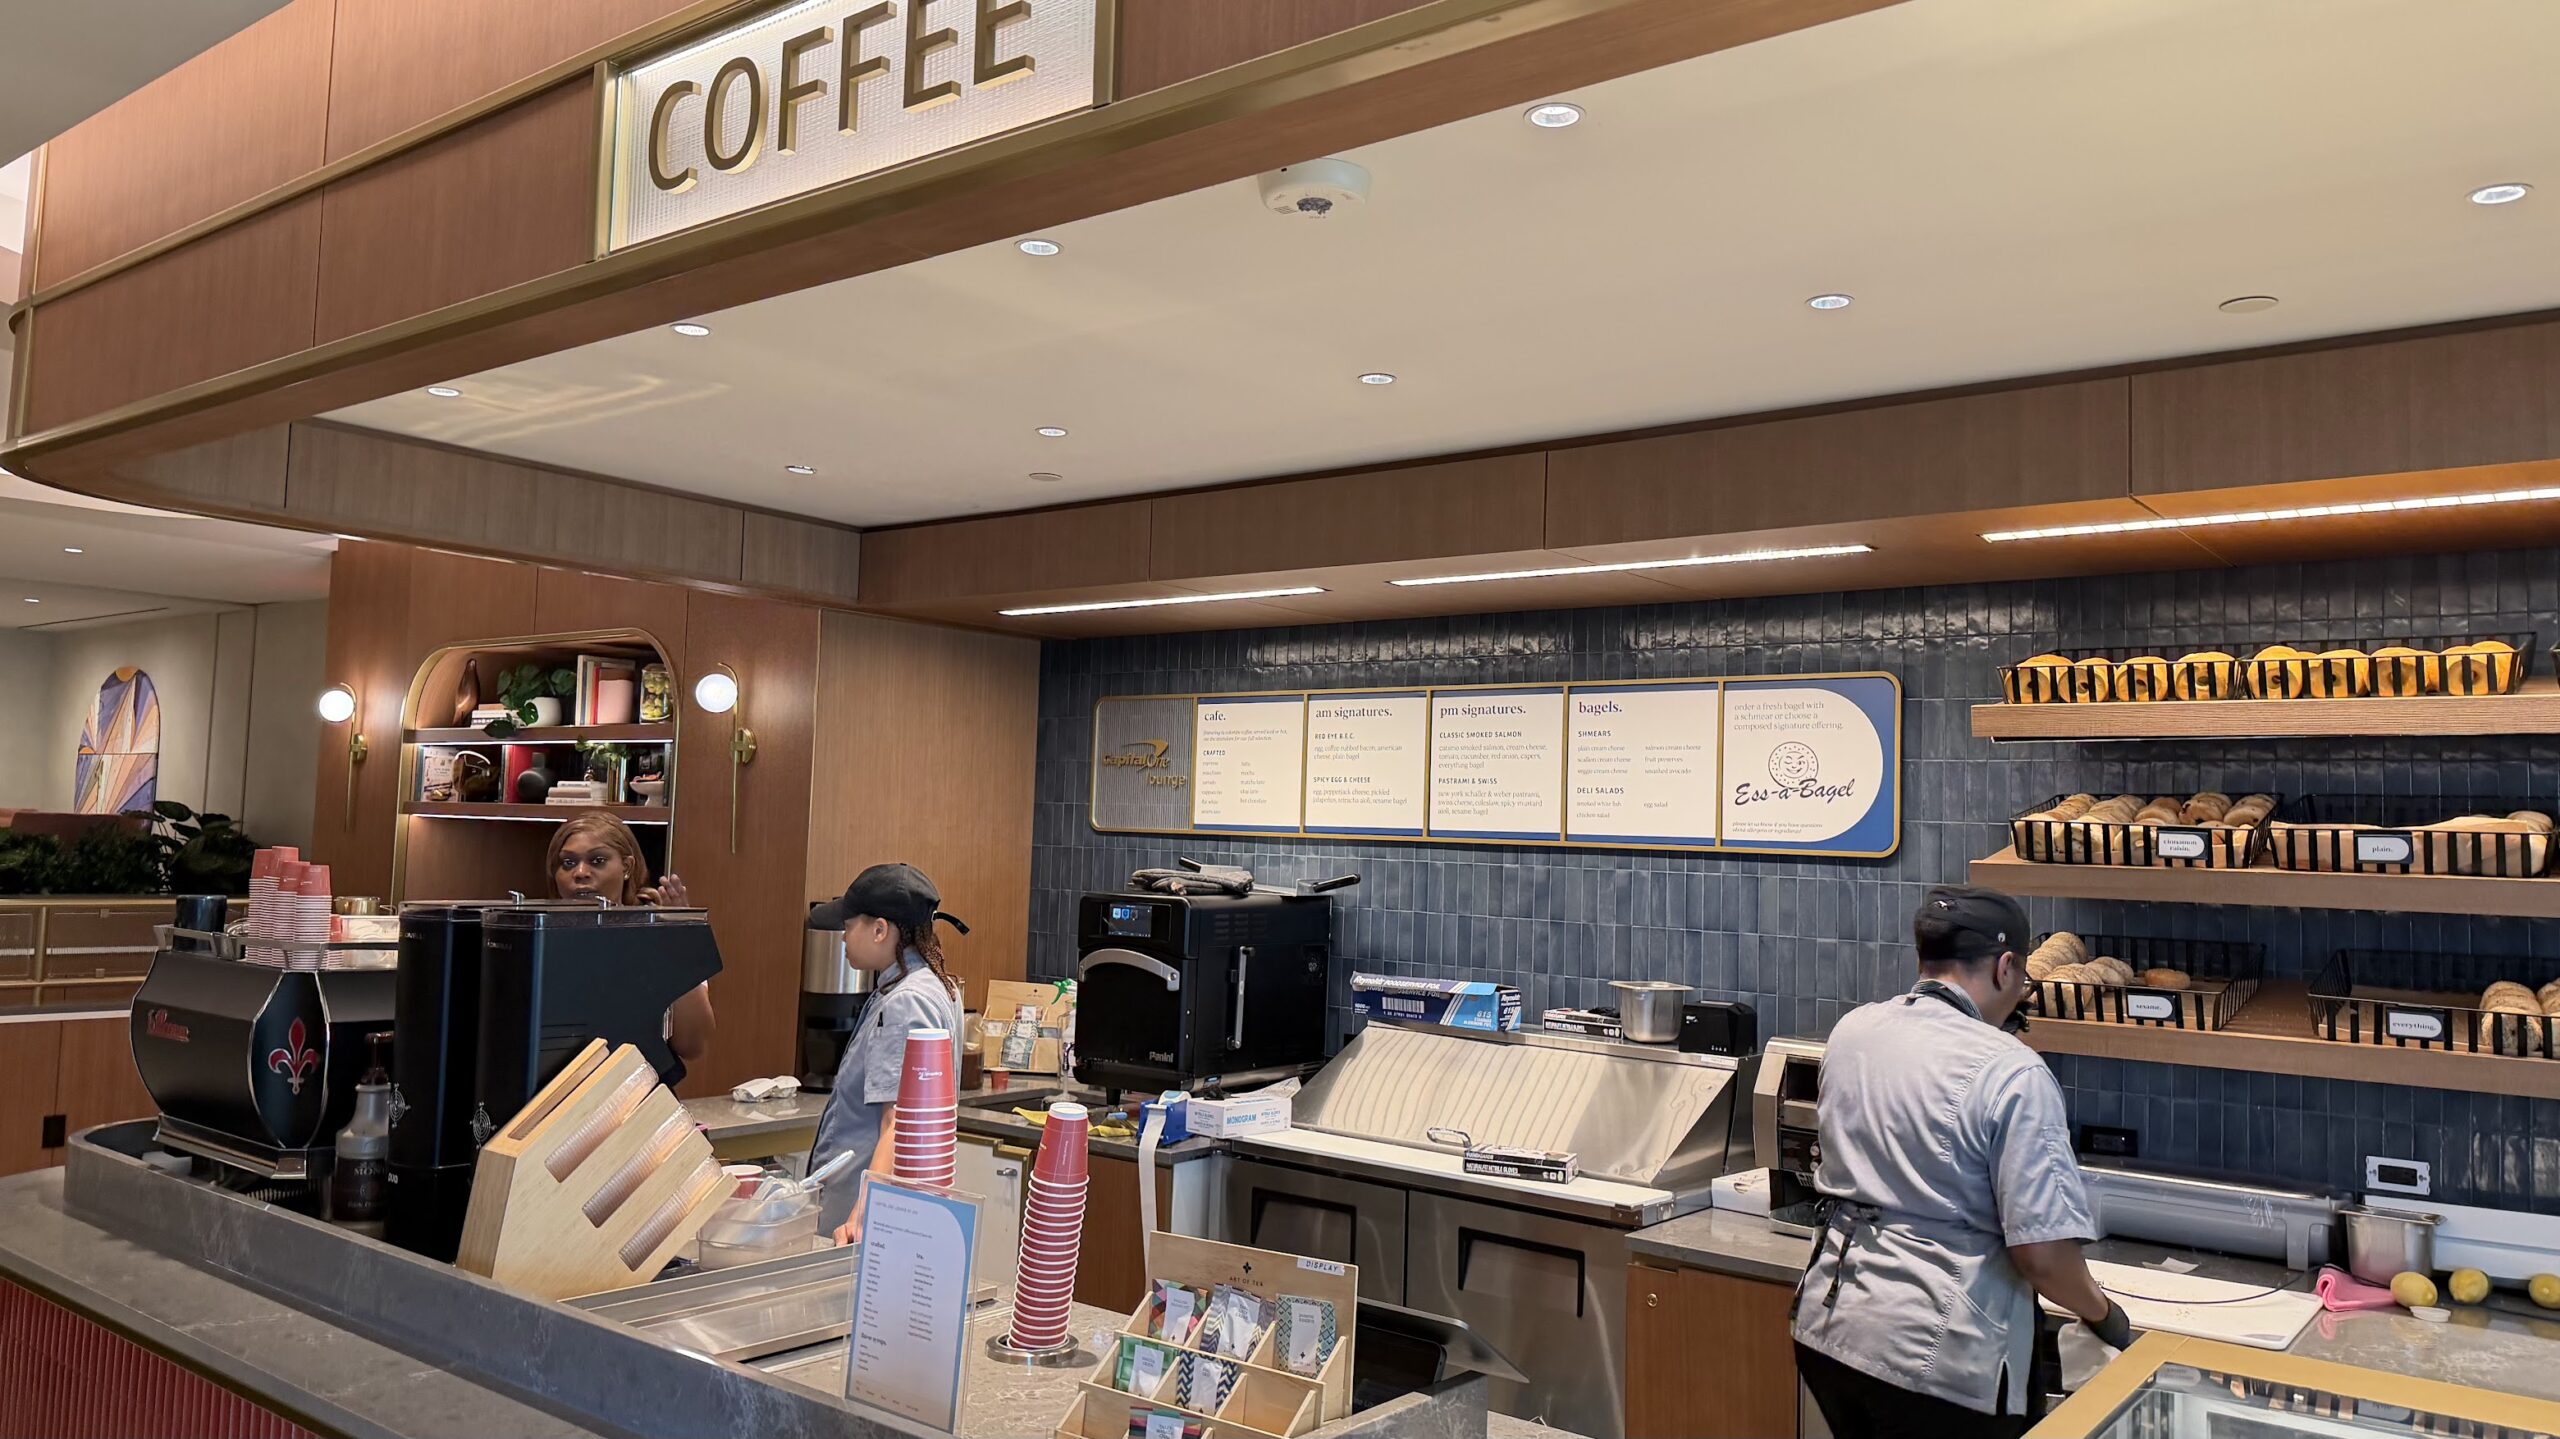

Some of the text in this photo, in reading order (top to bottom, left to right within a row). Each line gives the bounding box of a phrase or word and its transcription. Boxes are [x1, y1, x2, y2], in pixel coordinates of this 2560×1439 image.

[648, 0, 1036, 196] COFFEE
[1578, 700, 1623, 717] bagels.
[1734, 702, 1755, 711] order
[1762, 701, 1783, 710] fresh
[1784, 701, 1805, 711] bagel
[1806, 701, 1825, 709] with
[1204, 710, 1226, 721] cafe.
[1315, 706, 1393, 720] am signatures.
[1440, 704, 1527, 719] pm signatures.
[1740, 712, 1773, 720] schmear
[1784, 711, 1811, 720] choose
[1734, 721, 1772, 732] composed
[1773, 721, 1810, 731] signature
[1439, 731, 1464, 739] CLASSIC
[1494, 730, 1522, 738] SALMON
[1578, 730, 1612, 738] SHMEARS
[1346, 753, 1360, 761] bagel
[1491, 752, 1501, 760] red
[1520, 753, 1541, 761] capers,
[1438, 761, 1485, 770] everything bagel
[1148, 772, 1186, 789] lounge
[1438, 777, 1470, 785] PASTRAMI
[1477, 777, 1498, 785] SWISS
[1370, 788, 1390, 796] pickled
[1450, 790, 1463, 798] york
[1595, 787, 1625, 795] SALADS
[1734, 778, 1855, 806] Ess-a-Bagel
[1392, 797, 1408, 805] bagel
[1500, 800, 1516, 808] spicy
[1517, 799, 1543, 807] mustard
[1473, 808, 1489, 816] bagel
[2372, 845, 2393, 853] plain.
[1353, 975, 1441, 990] Reynolds FOODSERVICE FOIL
[1476, 1010, 1492, 1018] 615
[2392, 1022, 2437, 1031] everything.
[1226, 1113, 1257, 1125] MONOGRAM
[1306, 1260, 1339, 1273] DISPLAY
